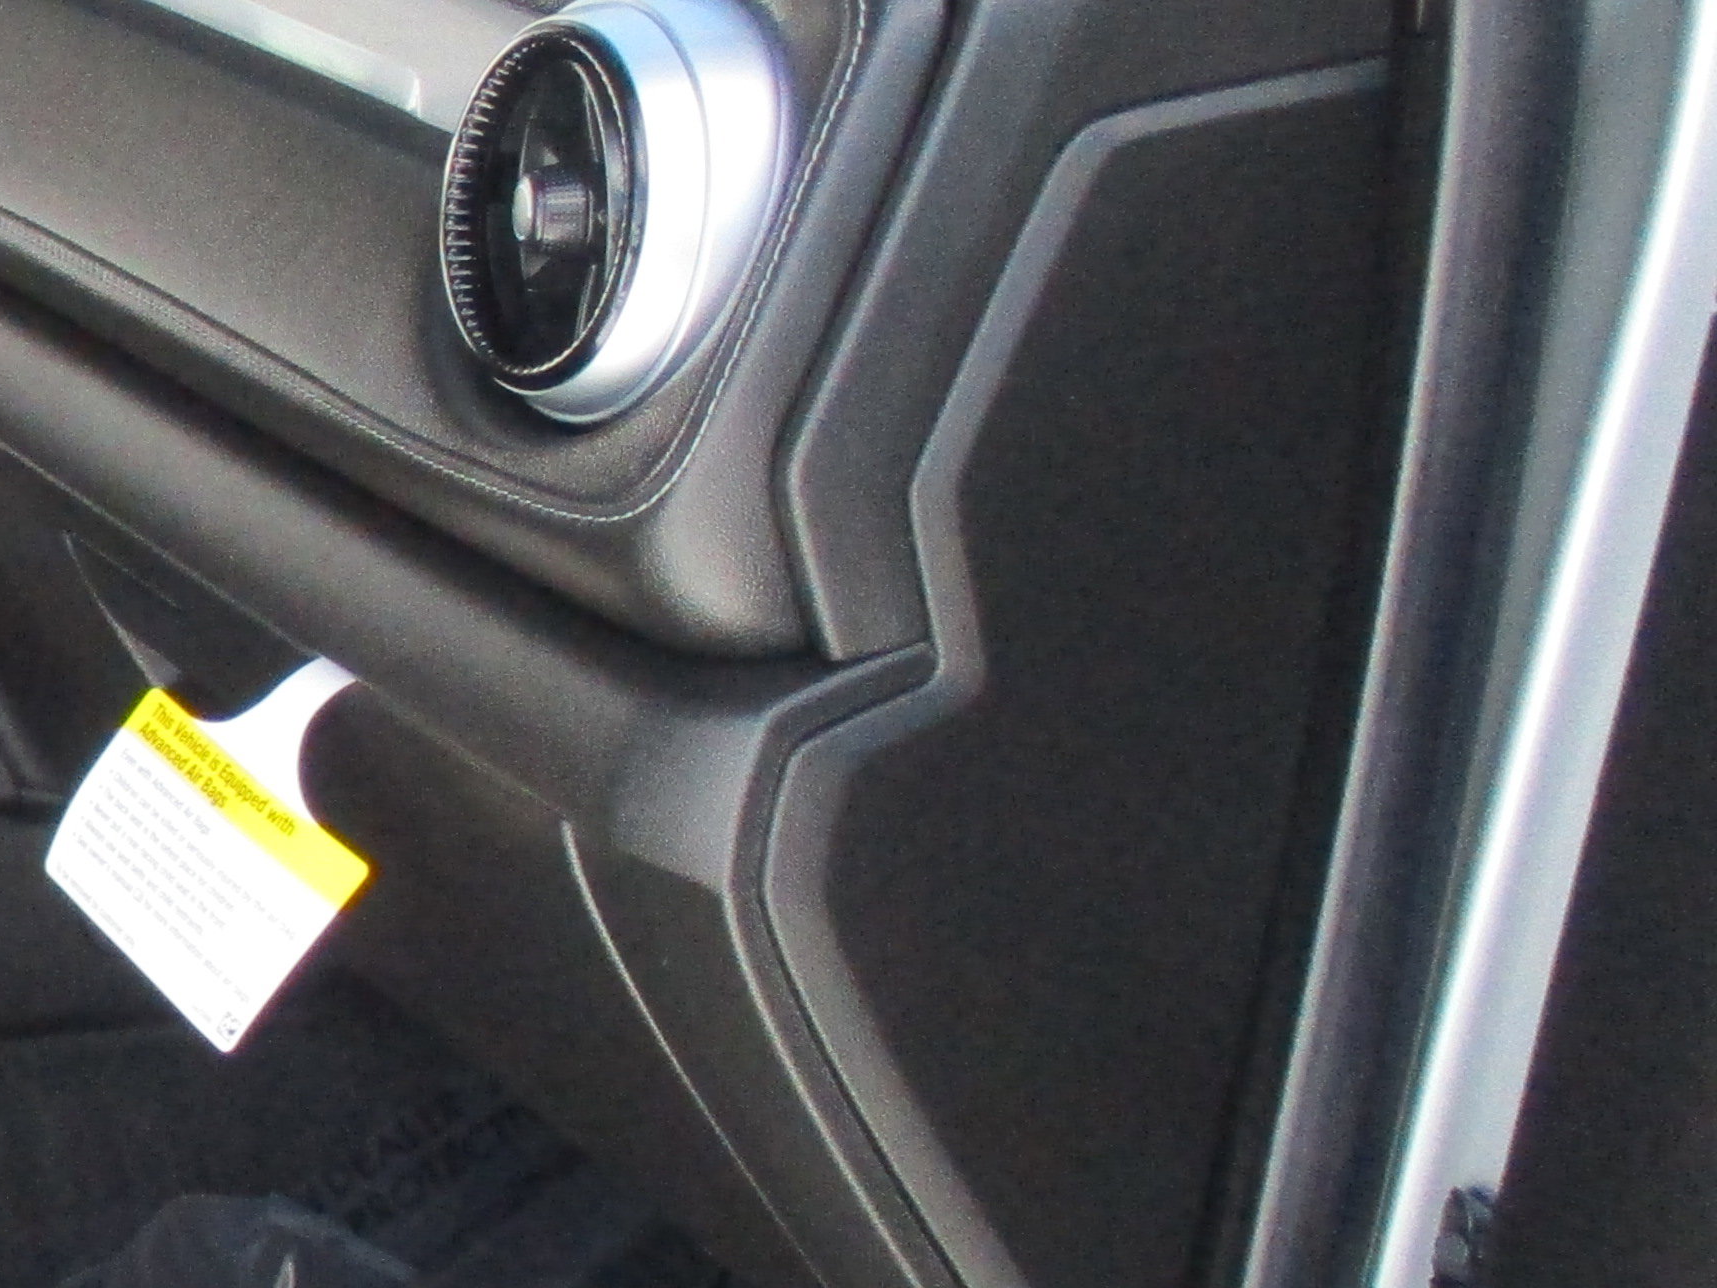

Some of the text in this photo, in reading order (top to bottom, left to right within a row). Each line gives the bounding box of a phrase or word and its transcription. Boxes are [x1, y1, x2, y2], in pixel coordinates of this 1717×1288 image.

[138, 722, 228, 809] Advanced Air Bags
[153, 703, 295, 836] This Vehicle is Equipped with
